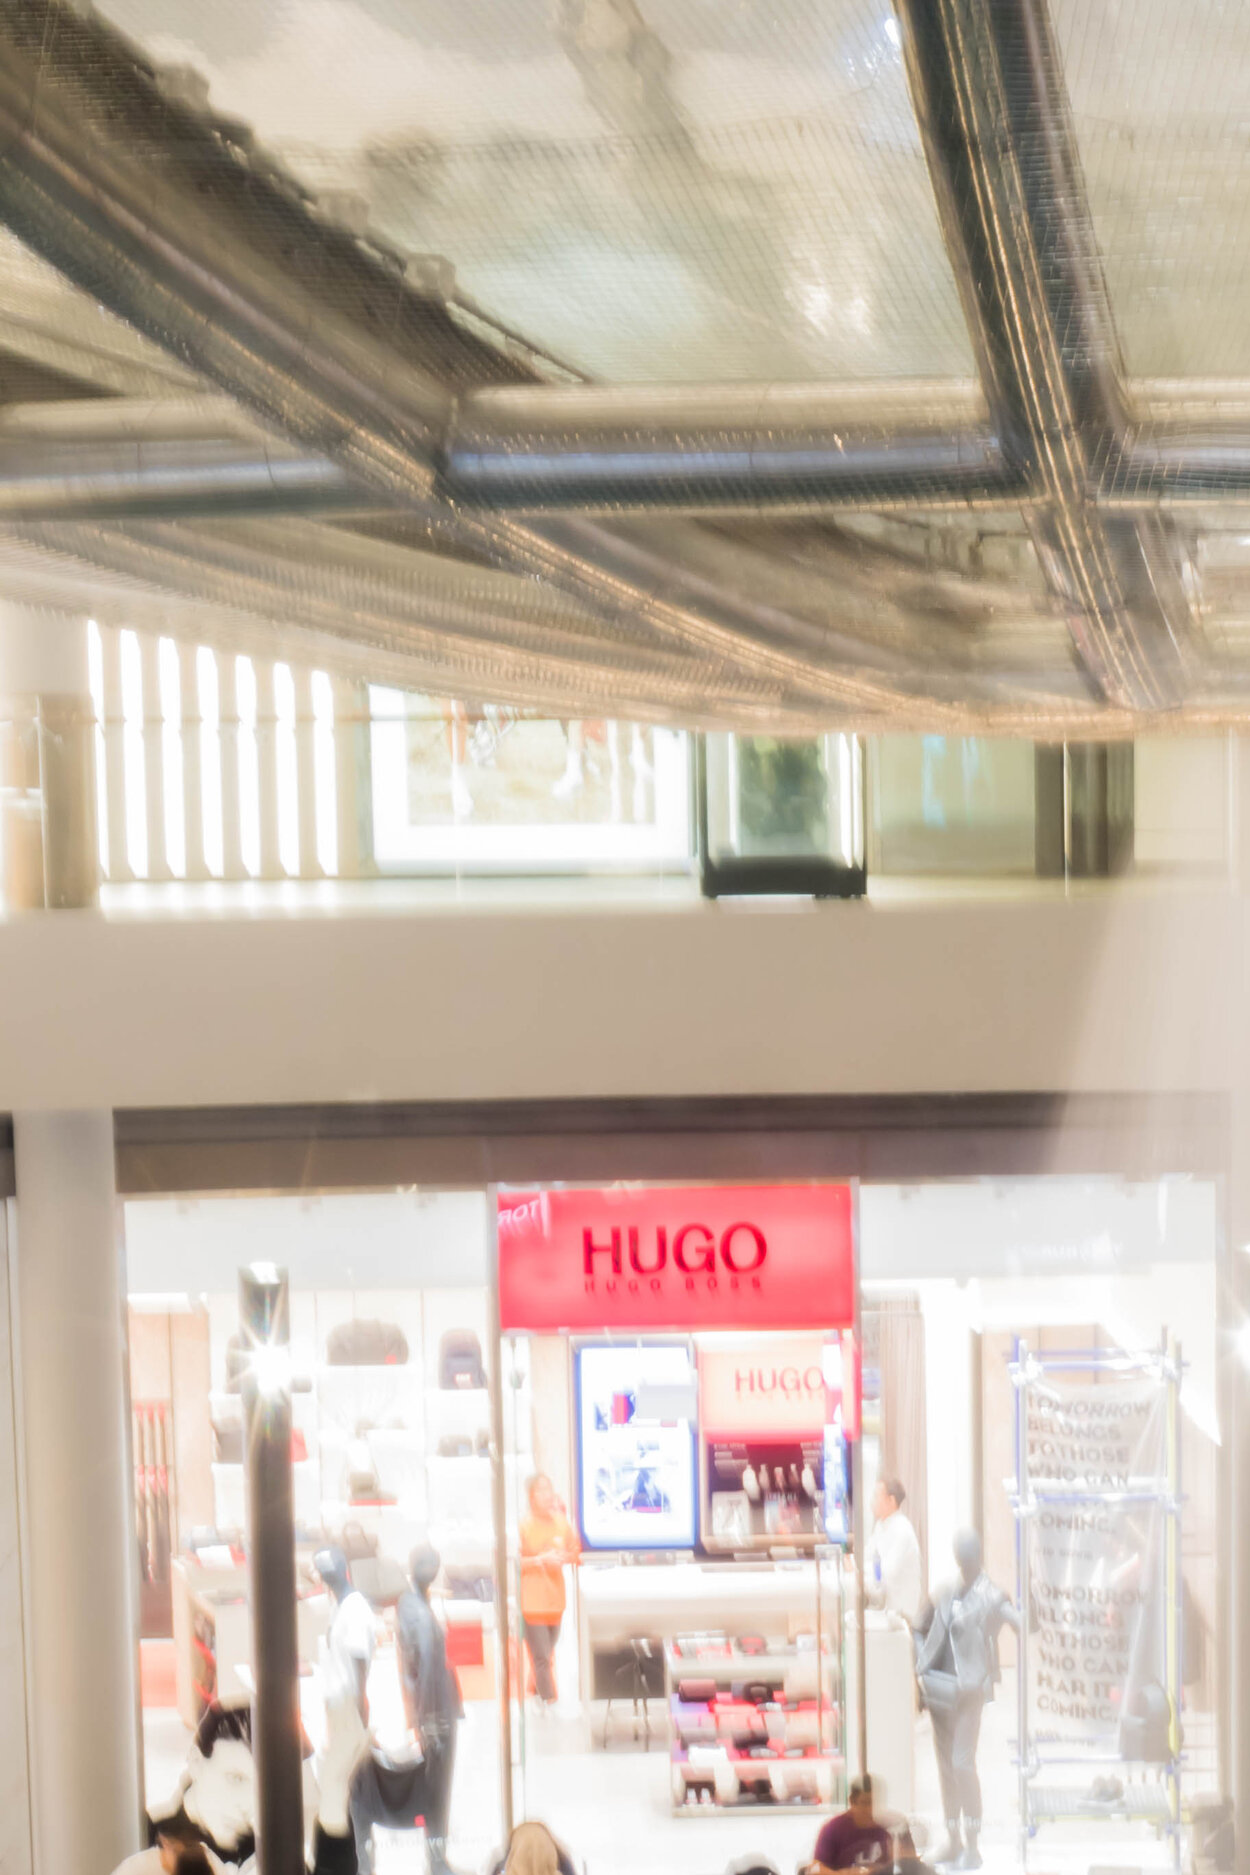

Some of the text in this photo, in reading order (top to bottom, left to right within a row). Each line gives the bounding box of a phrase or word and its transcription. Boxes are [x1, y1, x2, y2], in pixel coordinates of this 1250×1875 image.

[582, 1221, 768, 1275] HUGO
[584, 1275, 761, 1292] HUGO BOSS
[734, 1366, 825, 1392] HUGO
[1027, 1463, 1129, 1492] WHO CAN
[1084, 1657, 1130, 1674] CAN
[1093, 1682, 1113, 1699] IT
